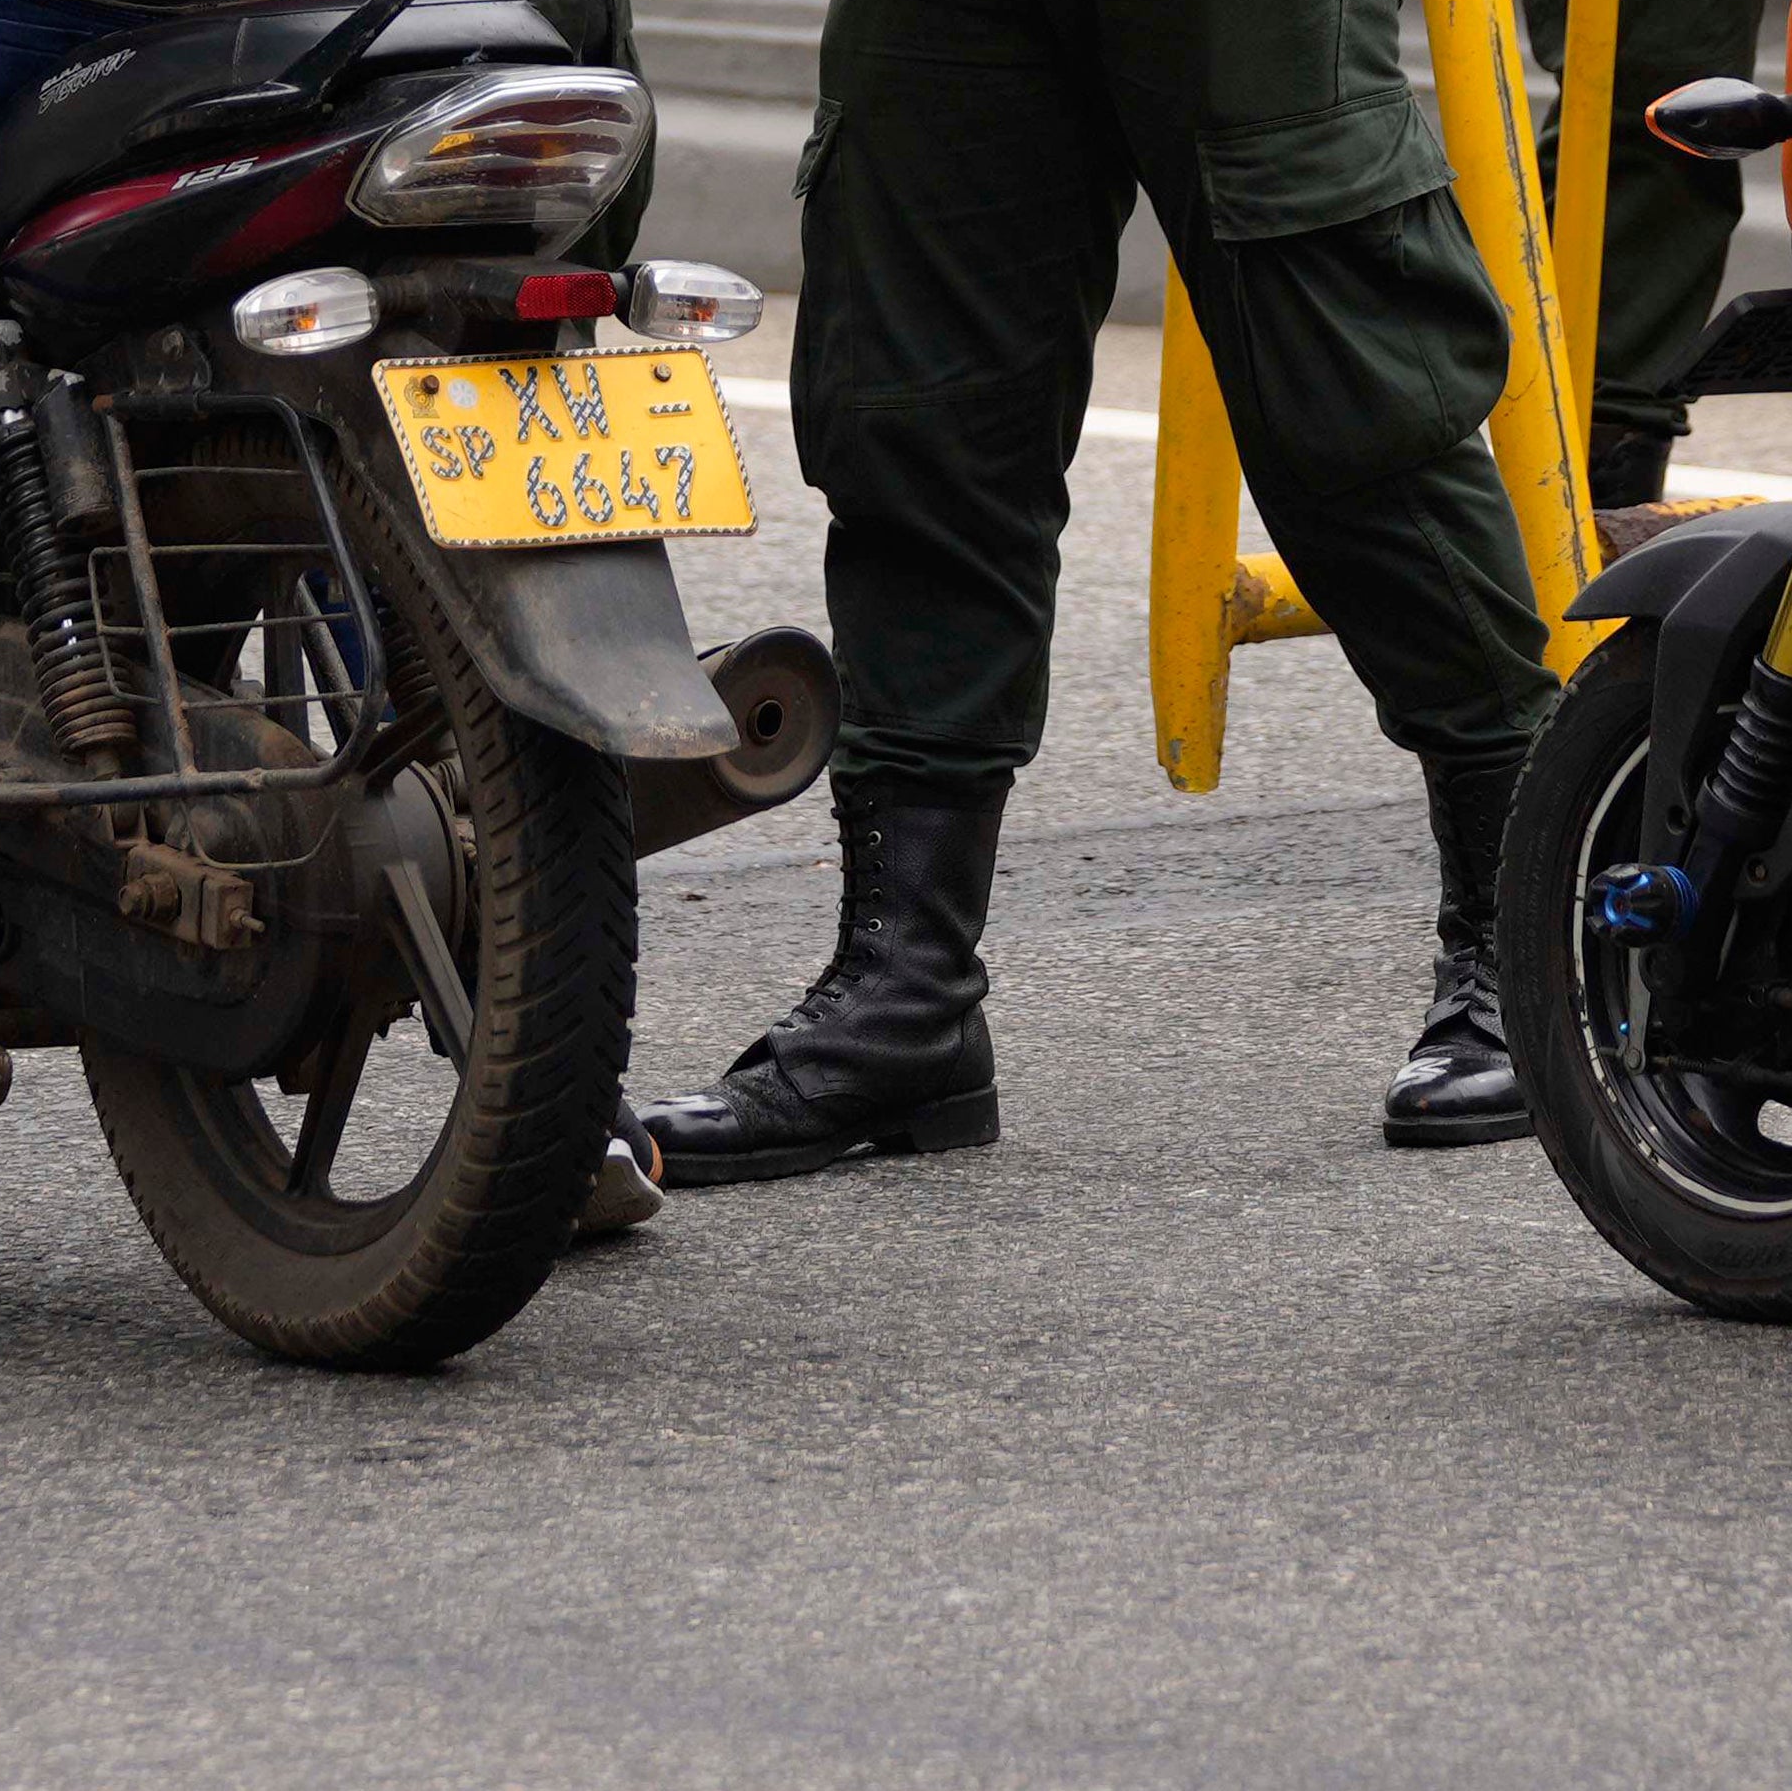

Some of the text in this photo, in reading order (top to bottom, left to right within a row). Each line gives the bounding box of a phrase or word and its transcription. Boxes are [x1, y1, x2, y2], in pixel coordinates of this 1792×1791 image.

[171, 156, 260, 191] 125
[498, 362, 610, 444] XW
[420, 424, 496, 481] SP
[525, 444, 695, 529] 6647
